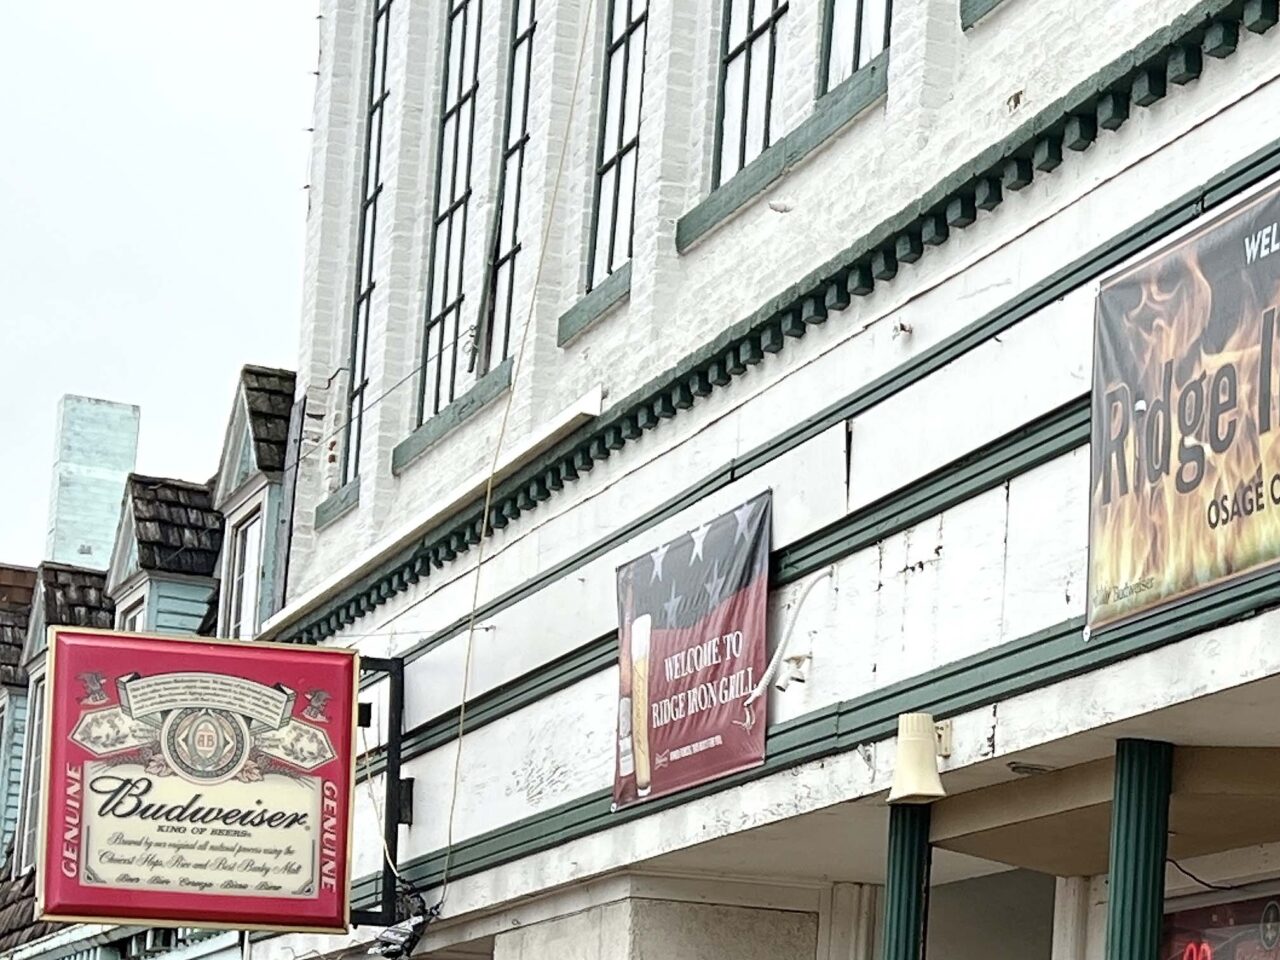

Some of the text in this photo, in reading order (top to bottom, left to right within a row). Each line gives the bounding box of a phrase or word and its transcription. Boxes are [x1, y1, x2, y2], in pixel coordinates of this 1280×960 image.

[1101, 357, 1238, 506] Ridge
[1207, 480, 1266, 529] OSAGE
[664, 630, 743, 682] WELCOME TO
[651, 667, 757, 729] RIDGE IRON GRILL
[61, 762, 82, 878] GENUINE
[89, 775, 309, 829] Budweiser
[157, 825, 249, 837] KING OF BEERS
[321, 780, 339, 893] GENUINE
